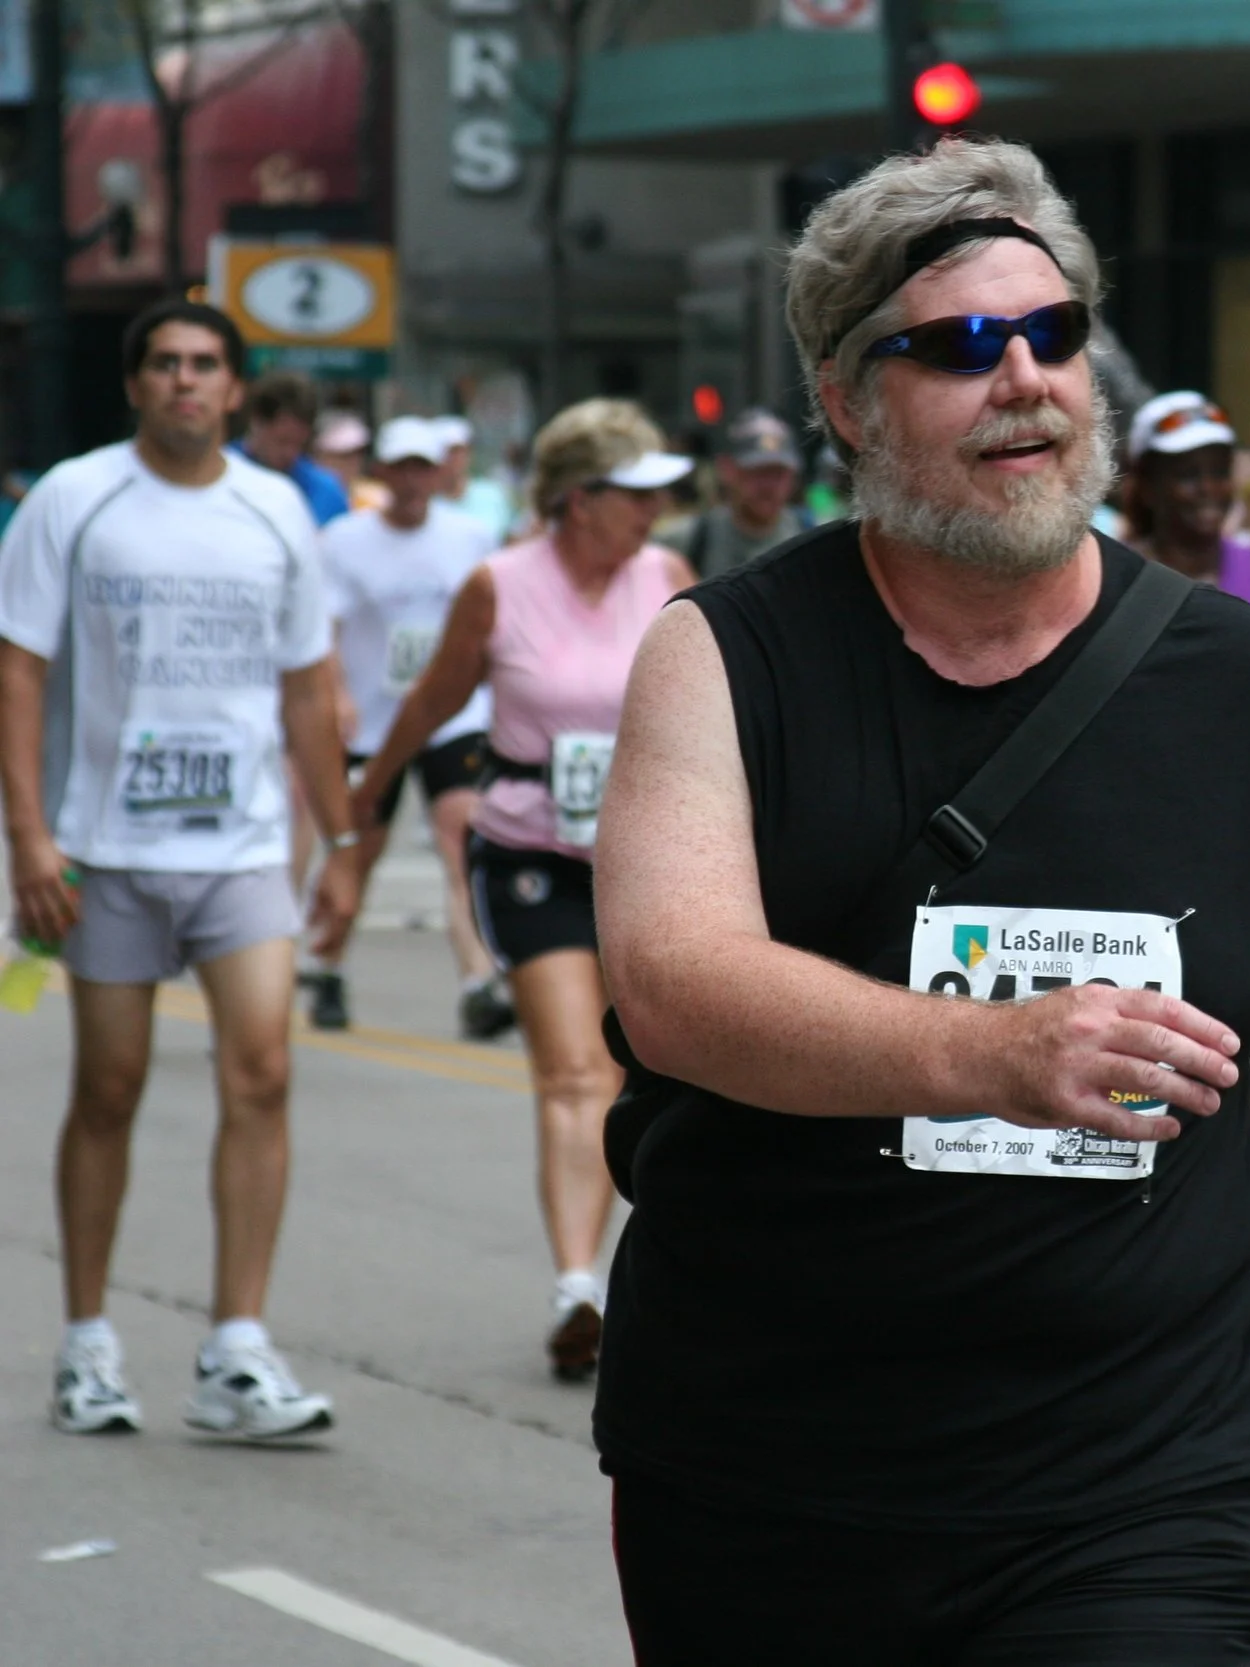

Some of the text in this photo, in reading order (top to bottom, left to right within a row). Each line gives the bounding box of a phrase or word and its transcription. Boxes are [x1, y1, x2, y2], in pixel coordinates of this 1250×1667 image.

[453, 0, 519, 190] RS
[290, 266, 321, 318] 2
[1001, 928, 1147, 957] LaSalle Bank
[998, 959, 1073, 975] ABN AMRO
[935, 1138, 1034, 1156] October 7, 2007
[1081, 1157, 1135, 1168] ANNIVERSARY
